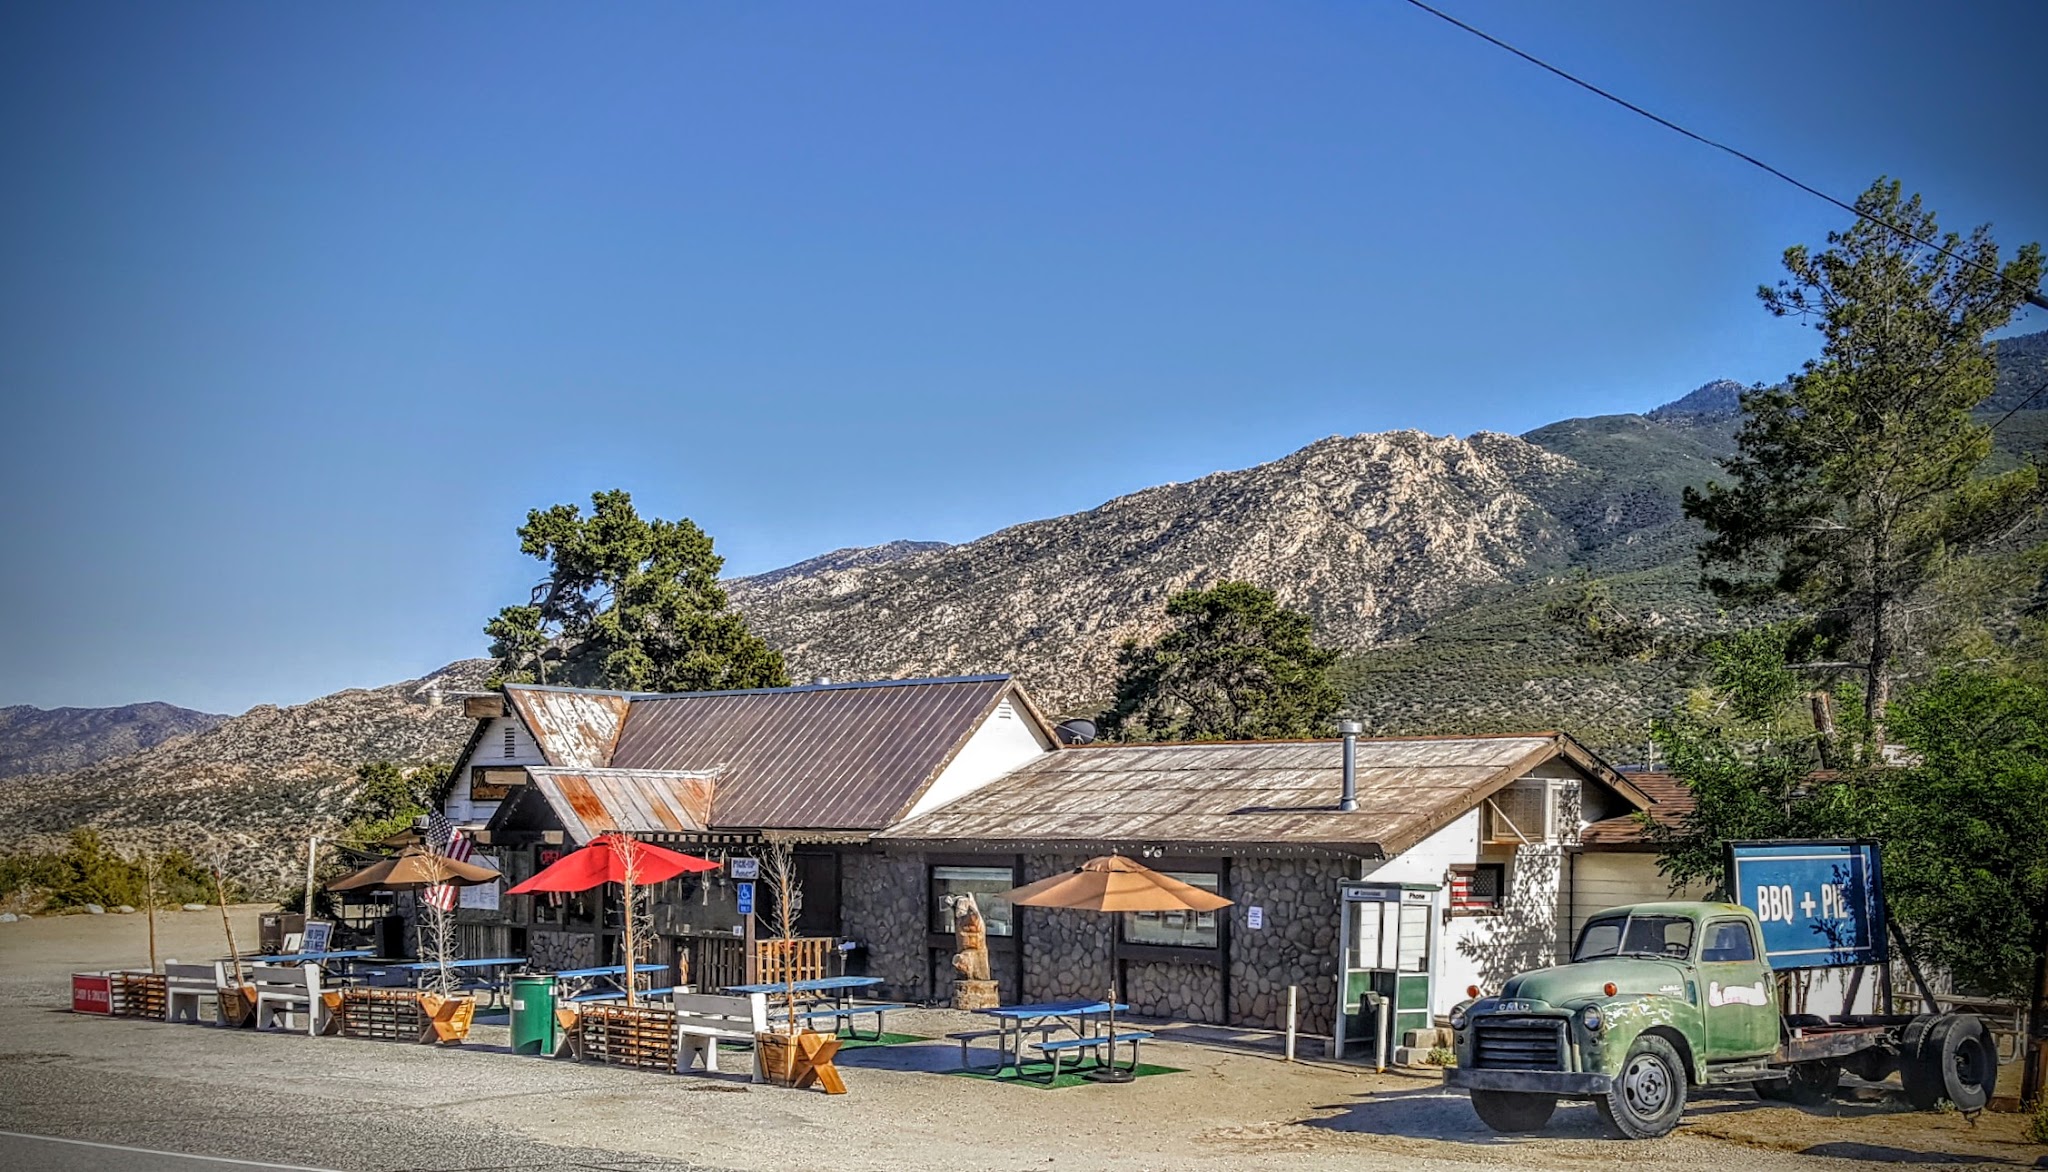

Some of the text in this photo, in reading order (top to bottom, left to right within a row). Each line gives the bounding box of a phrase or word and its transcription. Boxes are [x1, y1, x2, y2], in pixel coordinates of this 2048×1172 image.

[733, 860, 755, 868] PICK-UP
[1409, 892, 1425, 900] Phone
[1757, 885, 1793, 925] BBQ
[1821, 883, 1848, 919] PIE
